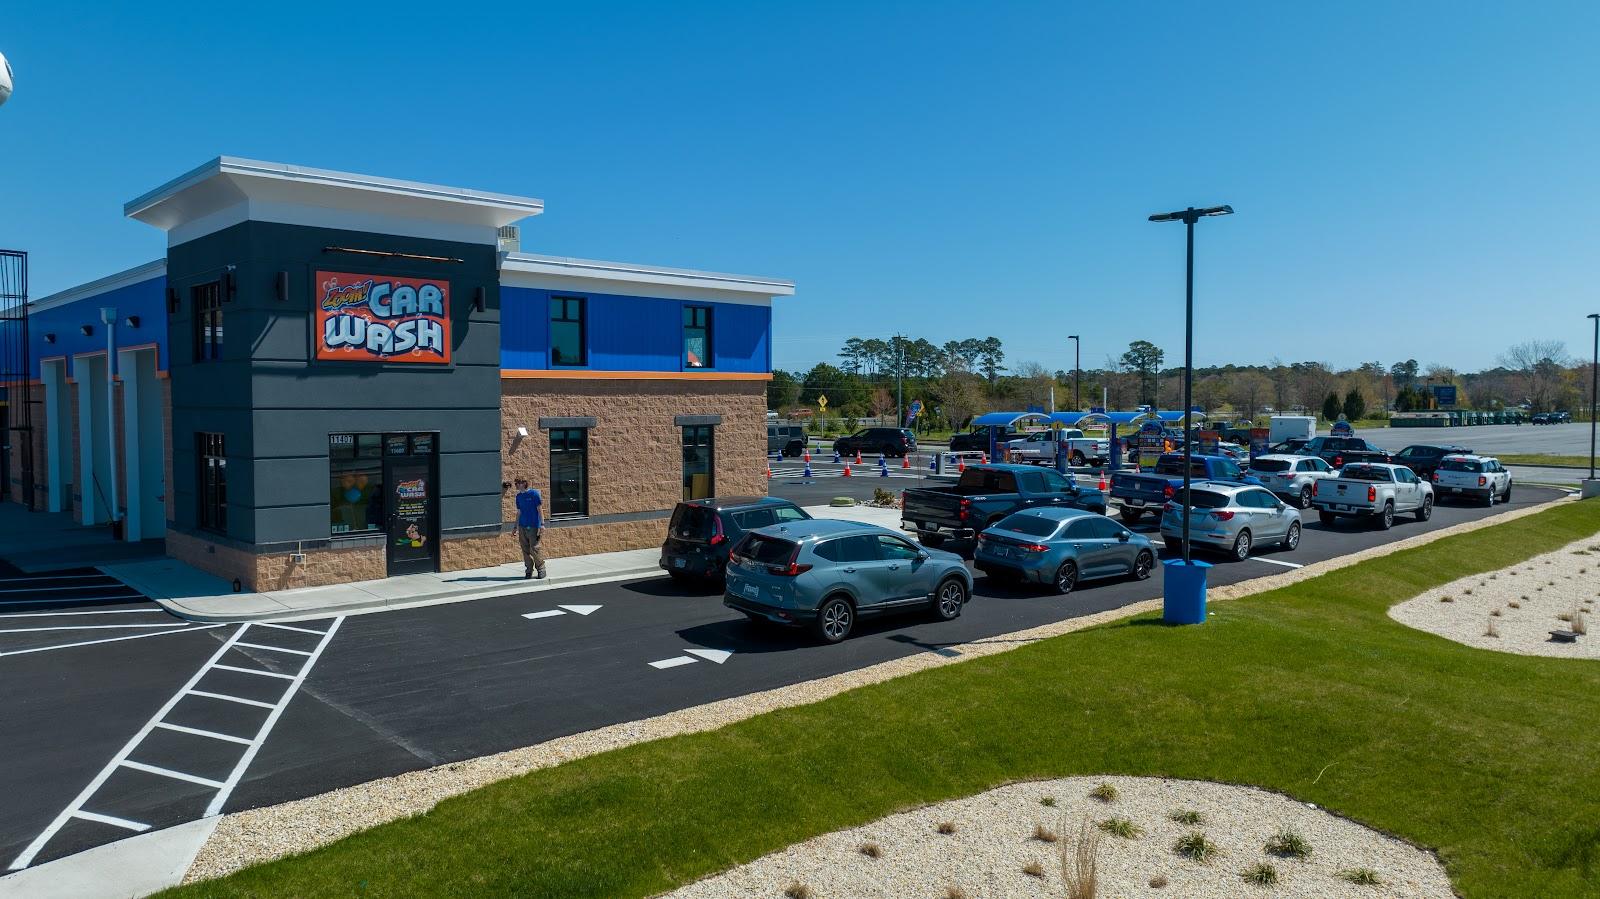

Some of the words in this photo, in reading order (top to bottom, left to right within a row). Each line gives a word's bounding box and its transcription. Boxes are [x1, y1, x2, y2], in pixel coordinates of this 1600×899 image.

[368, 282, 444, 318] CAR
[324, 314, 443, 355] WASH
[330, 435, 353, 444] 11407
